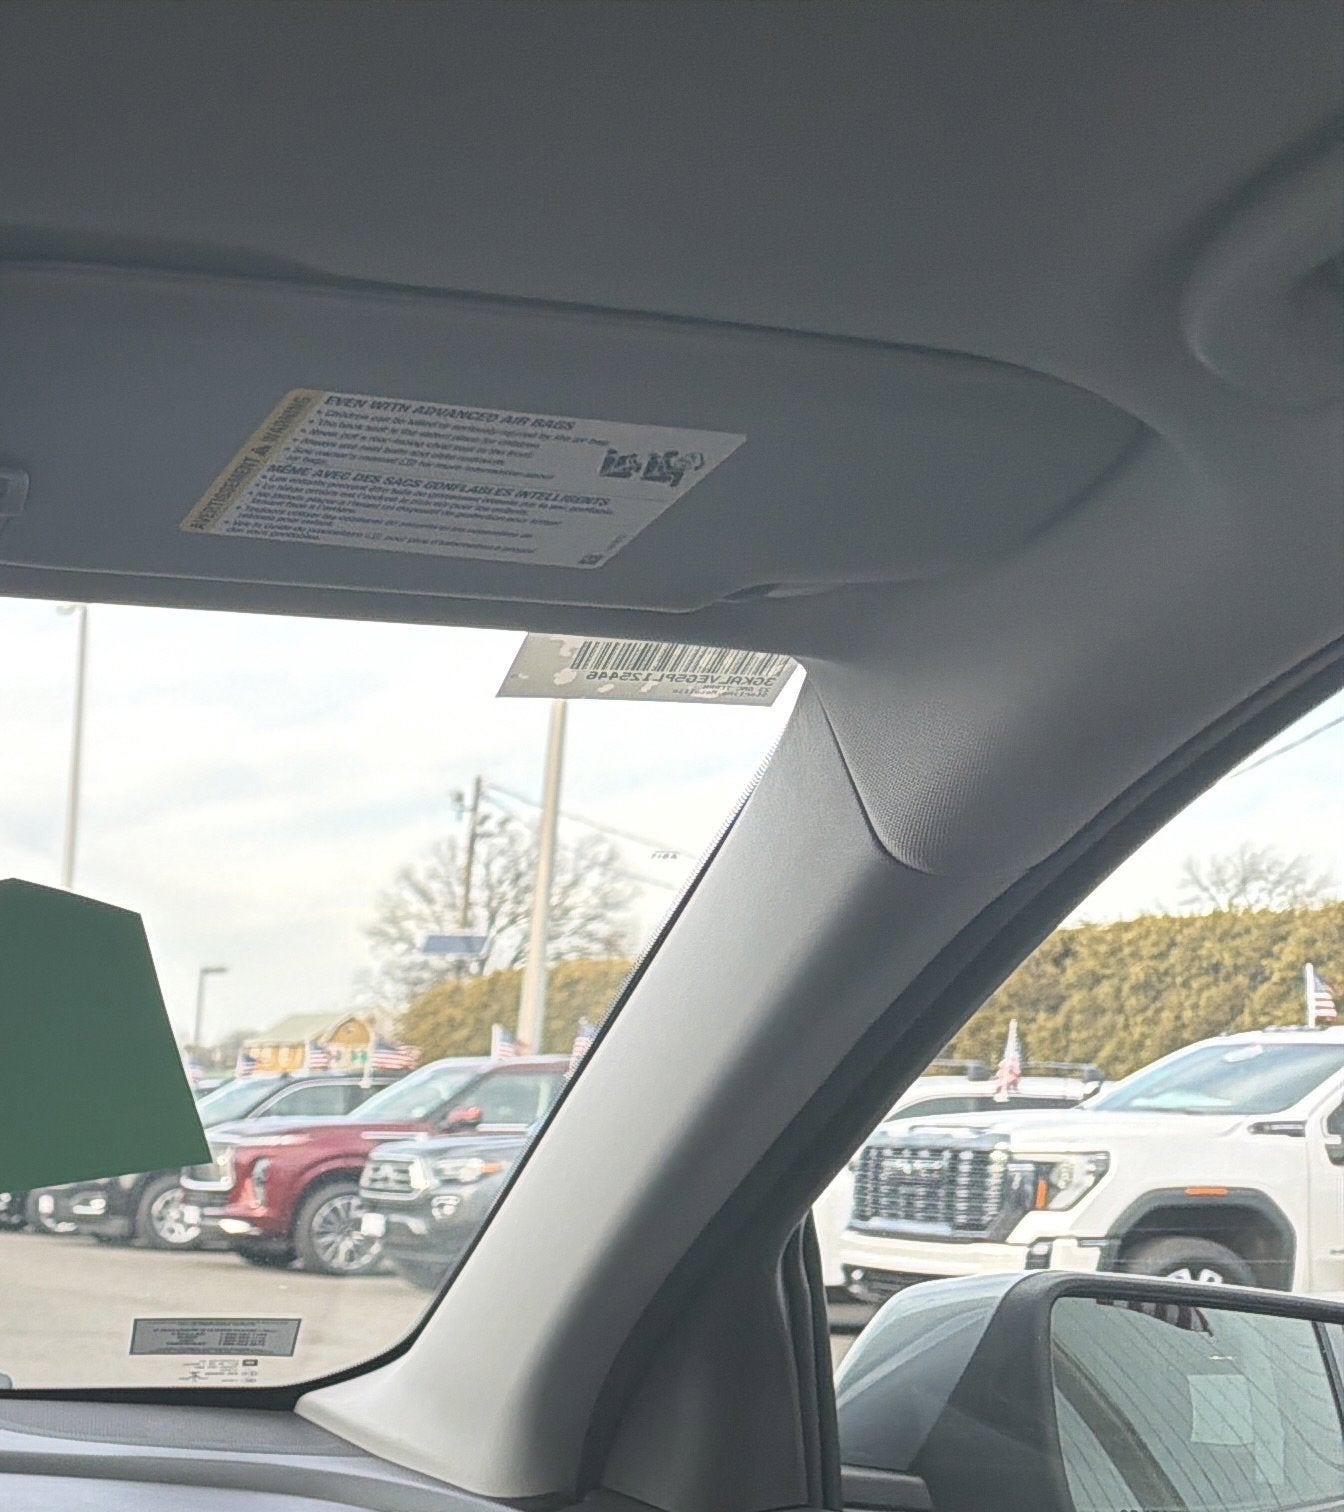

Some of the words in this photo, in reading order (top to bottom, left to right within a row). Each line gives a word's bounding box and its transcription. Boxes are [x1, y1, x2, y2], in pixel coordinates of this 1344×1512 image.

[325, 395, 366, 409] EVEN
[370, 401, 411, 413] WITH
[412, 404, 501, 421] ADVANCED
[500, 415, 531, 426] AIR
[531, 418, 577, 430] BAGS
[313, 469, 352, 481] AVEC
[353, 472, 382, 483] DES
[383, 476, 423, 488] SACS
